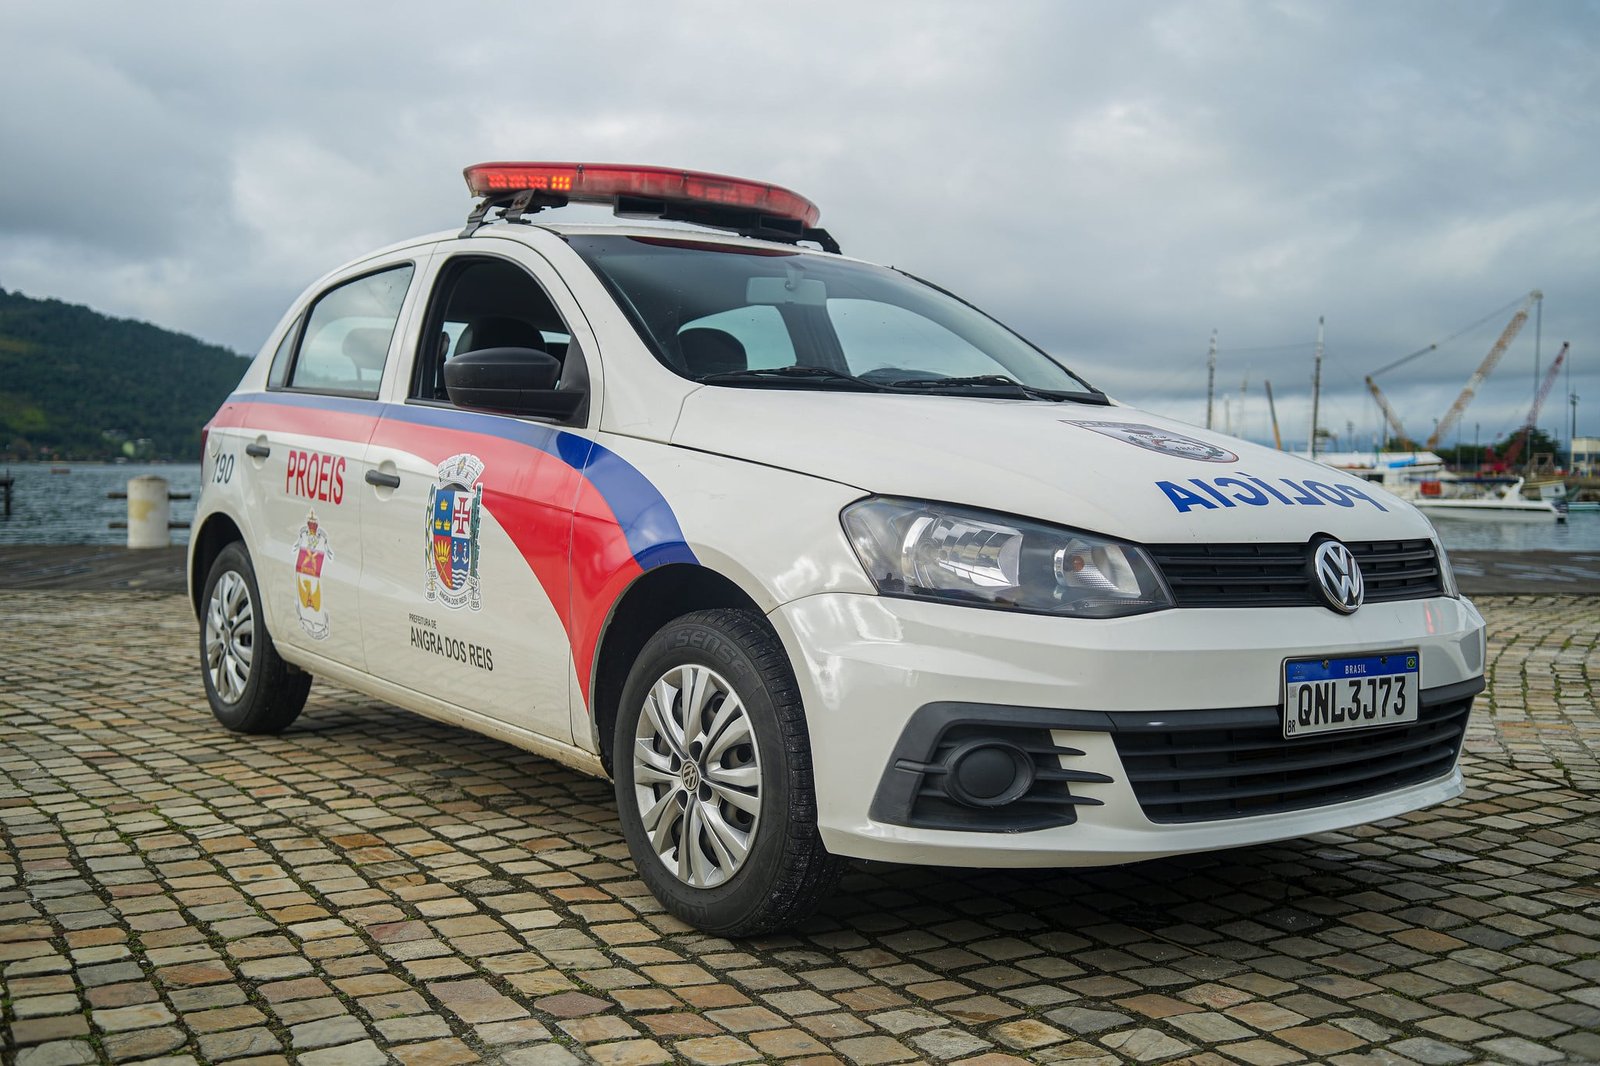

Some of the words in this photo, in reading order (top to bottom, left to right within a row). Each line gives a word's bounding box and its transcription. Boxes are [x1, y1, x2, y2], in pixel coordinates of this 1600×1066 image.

[212, 453, 234, 484] 190
[286, 450, 346, 505] PROEIS
[408, 612, 431, 627] PREFEITURA
[431, 619, 437, 629] DE
[410, 626, 444, 656] ANGRA
[445, 636, 467, 663] DOS
[468, 643, 494, 672] REIS
[1345, 664, 1366, 675] BRASIL
[1298, 676, 1406, 726] QNL3J73
[1288, 720, 1296, 733] BR
